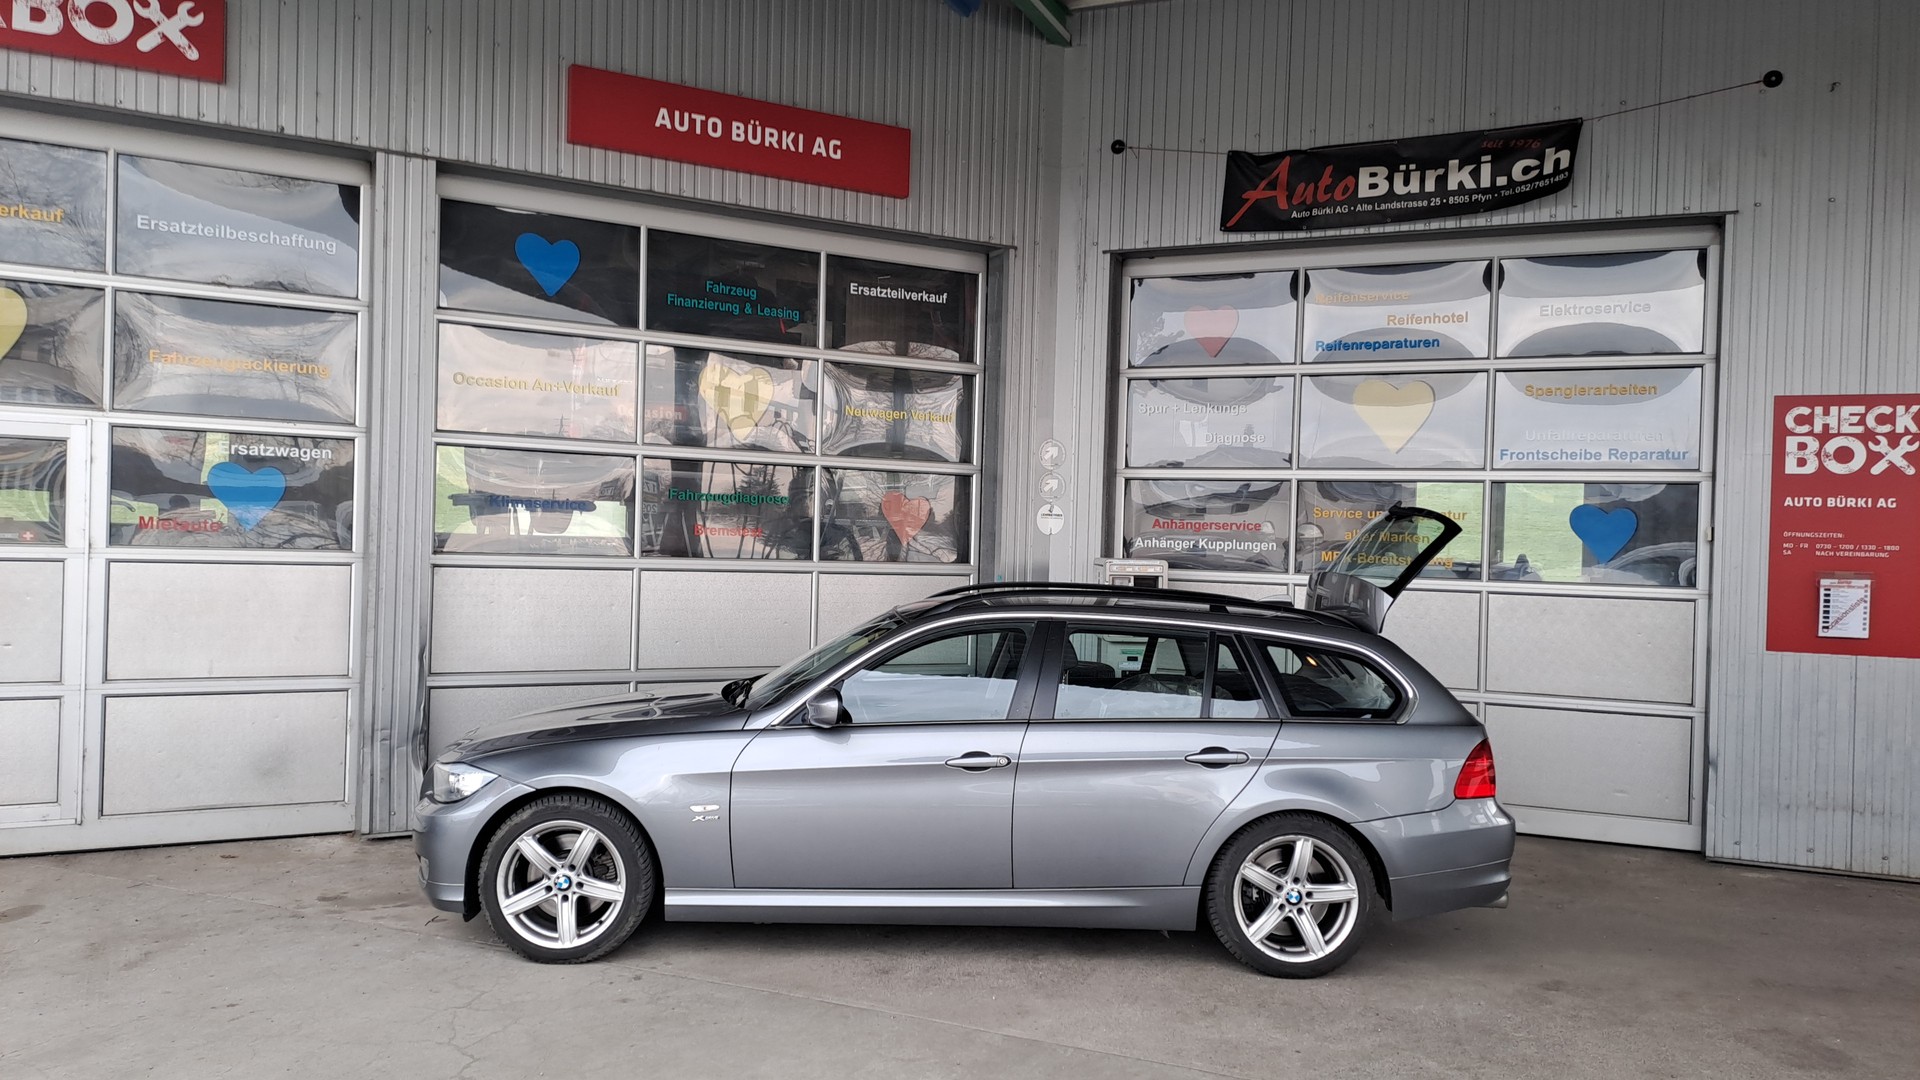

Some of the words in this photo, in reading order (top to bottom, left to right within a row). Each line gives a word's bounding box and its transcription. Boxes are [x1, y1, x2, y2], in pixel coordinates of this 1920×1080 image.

[0, 0, 204, 61] BOX
[655, 108, 722, 138] AUTO
[731, 120, 804, 153] BÜRKI
[812, 137, 842, 160] AG
[1510, 139, 1542, 149] 1976
[1291, 209, 1311, 219] Auto
[1312, 206, 1334, 216] Bürki
[1335, 204, 1349, 213] AG
[1356, 202, 1373, 212] Alte
[1375, 199, 1428, 211] Landstrasse
[1430, 197, 1441, 206] 25
[1449, 195, 1469, 204] 8505
[1472, 193, 1492, 203] Pfyn
[136, 214, 337, 255] Ersatzteilbeschaffung
[706, 280, 757, 300] Fahrzeug
[850, 282, 948, 304] Ersatzteilverkauf
[1315, 289, 1410, 304] Reifenservice
[667, 293, 740, 315] Finanzierung
[744, 303, 753, 315] &
[757, 303, 800, 322] Leasing
[1539, 301, 1652, 317] Elektroservice
[1386, 311, 1469, 326] Reifenhotel
[1315, 337, 1440, 352] Reifenreparaturen
[148, 349, 331, 379] Fahrzeuglackierung
[452, 371, 528, 390] Occasion
[1524, 384, 1658, 399] Spenglerarbeiten
[845, 405, 907, 422] Neuwagen
[911, 409, 955, 424] Verkauf
[1138, 402, 1169, 416] Spur
[1172, 404, 1180, 413] +
[1183, 402, 1248, 417] Lenkungs
[1784, 405, 1920, 434] CHECK
[1204, 433, 1266, 446] Diagnose
[218, 441, 332, 462] Ersatzwagen
[1500, 448, 1602, 462] Frontscheibe
[1608, 448, 1689, 463] Reparatur
[489, 494, 587, 511] Klimaservice
[669, 488, 790, 507] Fahrzeugdiagnose
[1784, 496, 1822, 507] AUTO
[1826, 495, 1872, 508] BÜRKI
[1876, 497, 1897, 508] AG
[1313, 507, 1363, 519] Service
[138, 516, 224, 533] Mietauto
[693, 523, 763, 538] Bremstest
[1152, 518, 1262, 533] Anhängerservice
[1135, 537, 1195, 550] Anhänger
[1199, 538, 1277, 552] Kupplungen
[1379, 531, 1430, 544] Marken
